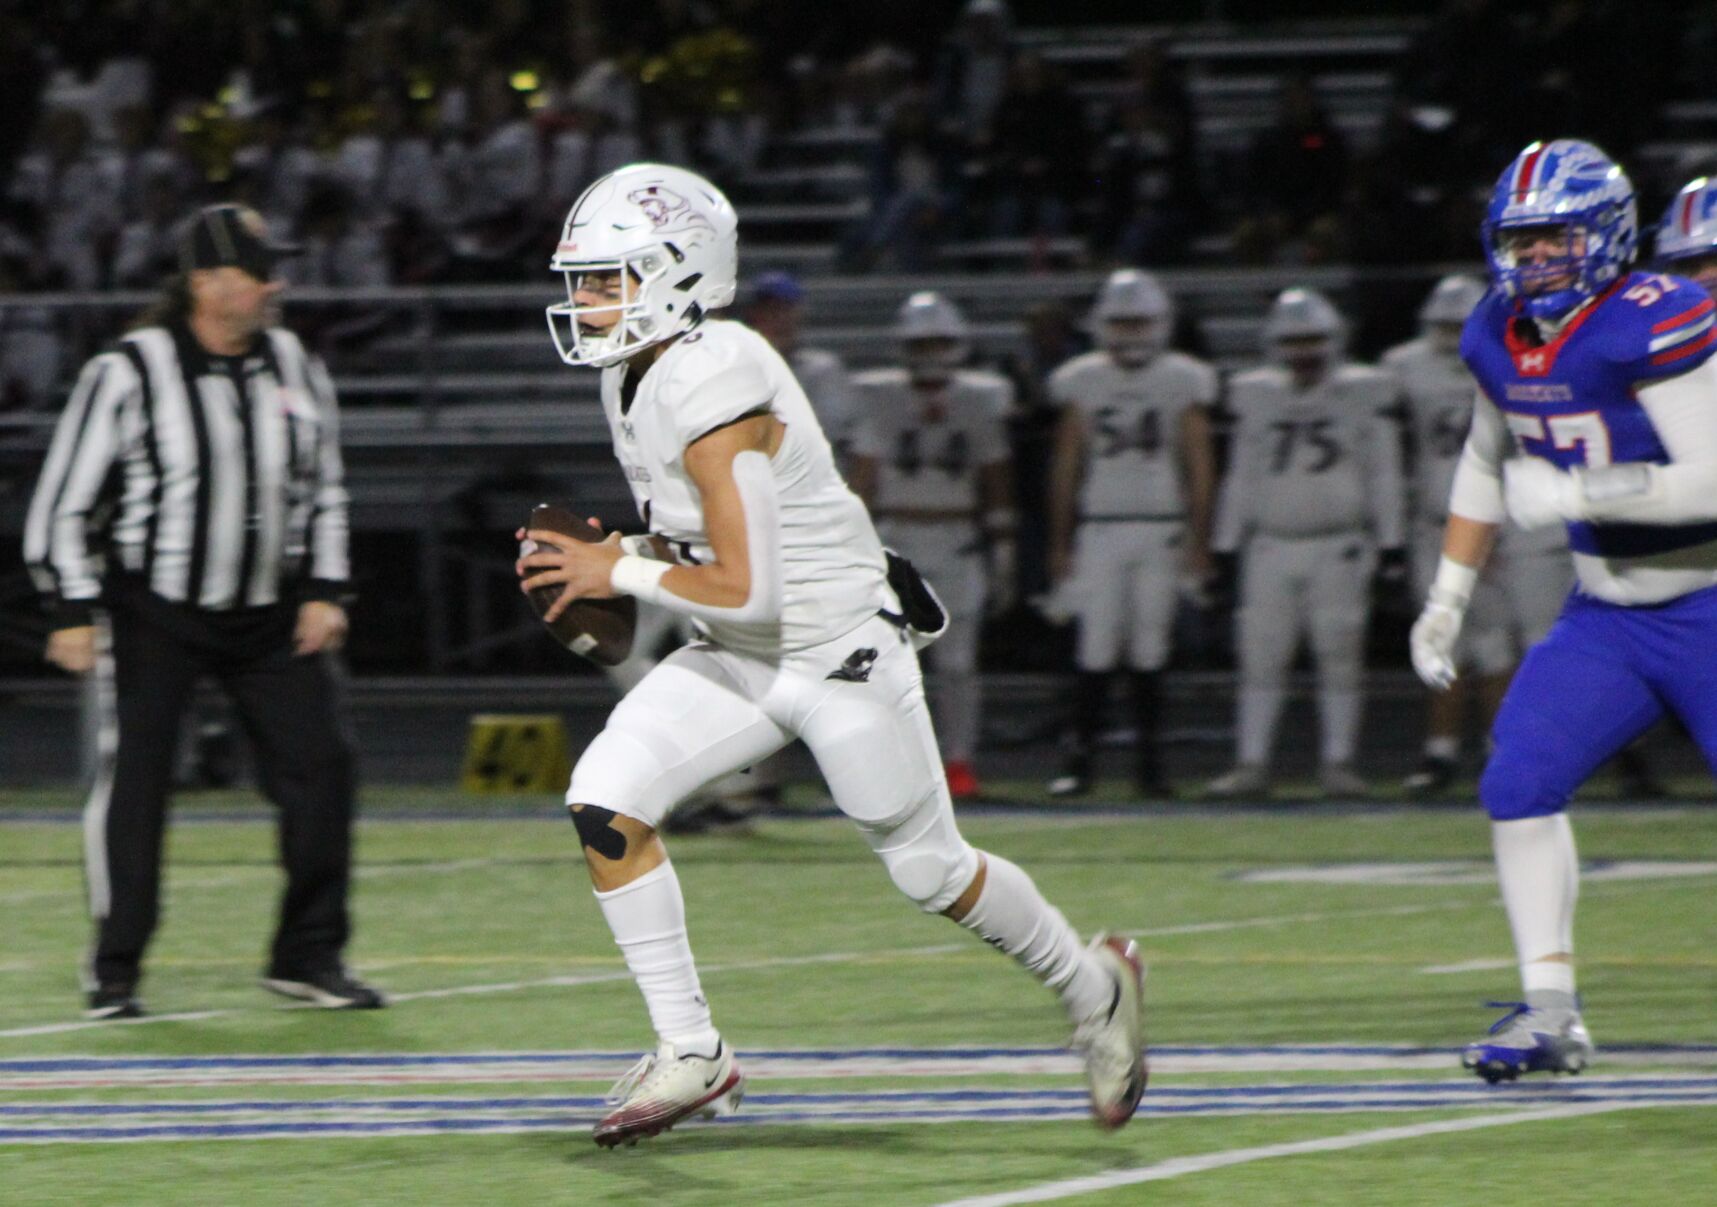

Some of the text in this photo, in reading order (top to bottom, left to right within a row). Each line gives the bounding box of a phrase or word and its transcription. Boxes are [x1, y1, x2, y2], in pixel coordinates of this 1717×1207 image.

[1622, 273, 1680, 307] 57
[1094, 404, 1162, 457] 54
[1268, 418, 1342, 474] 75
